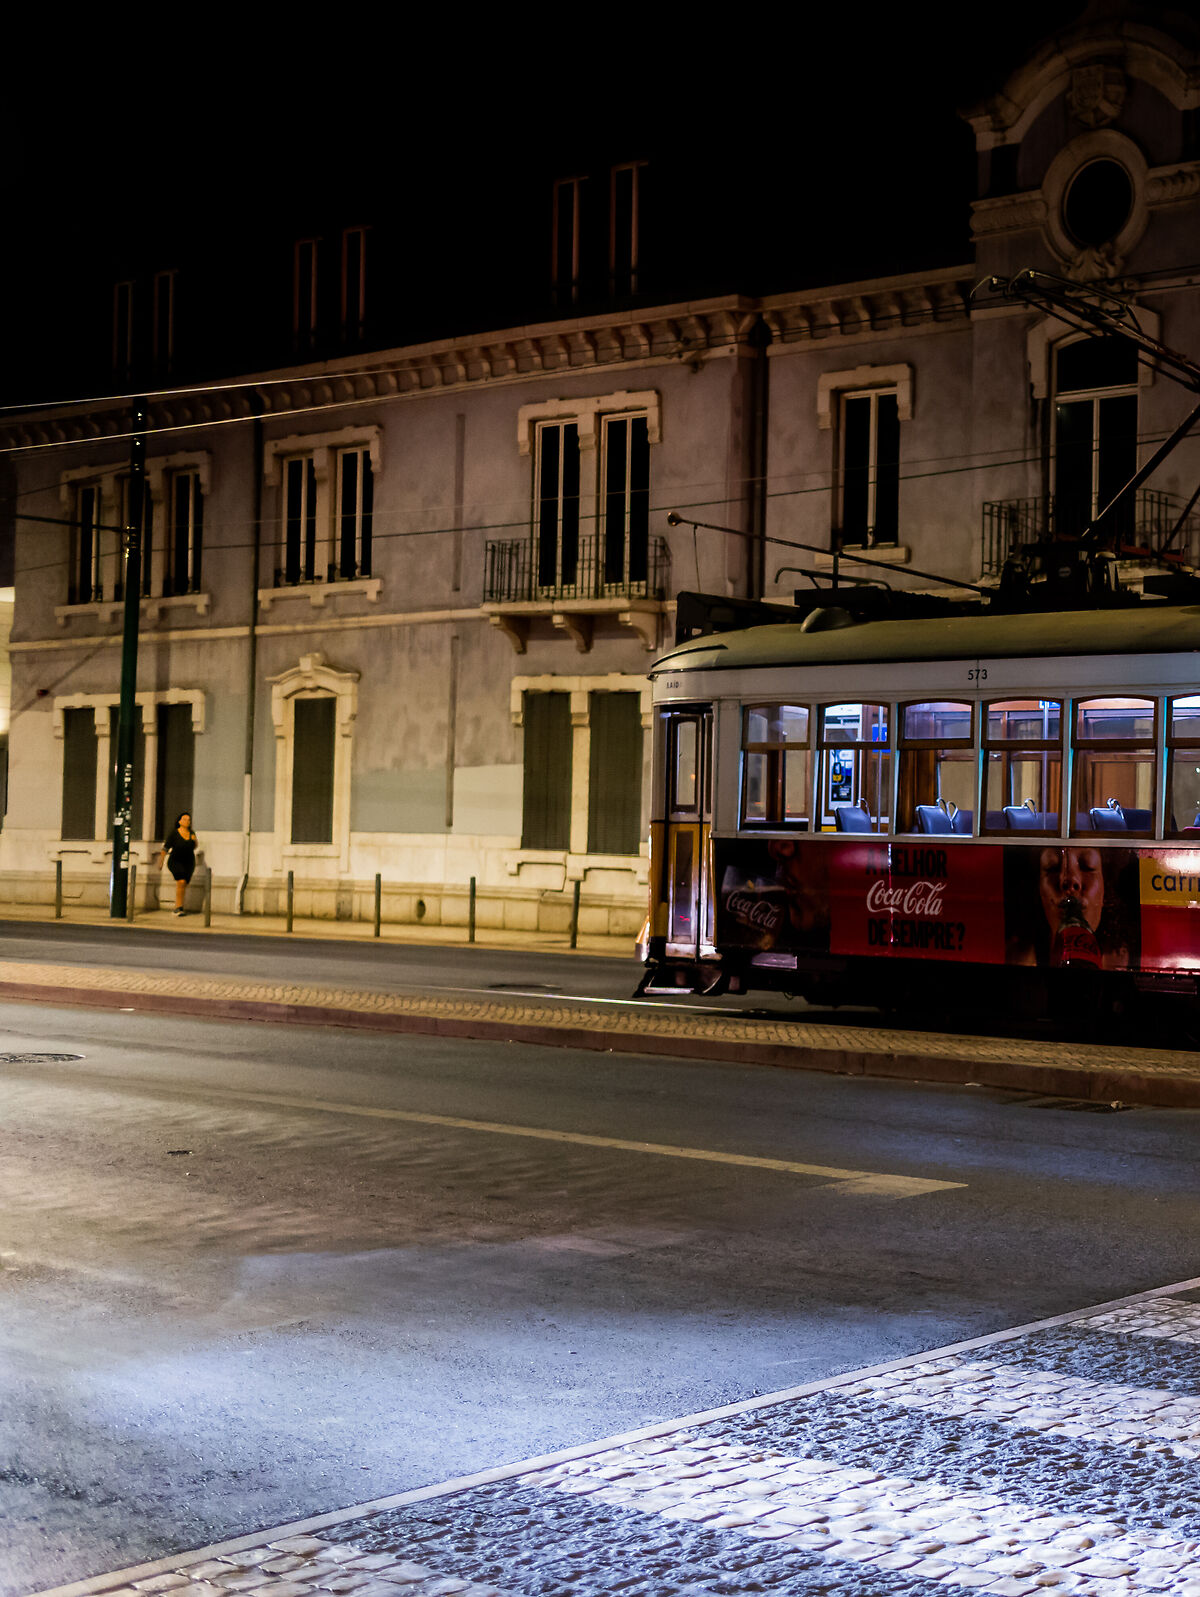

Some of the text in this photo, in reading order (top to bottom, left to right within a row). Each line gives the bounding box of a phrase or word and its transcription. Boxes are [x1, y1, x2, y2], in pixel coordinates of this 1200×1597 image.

[967, 669, 988, 681] 573
[880, 848, 947, 877] MELHOR
[868, 918, 966, 951] DE SEMPRE?
